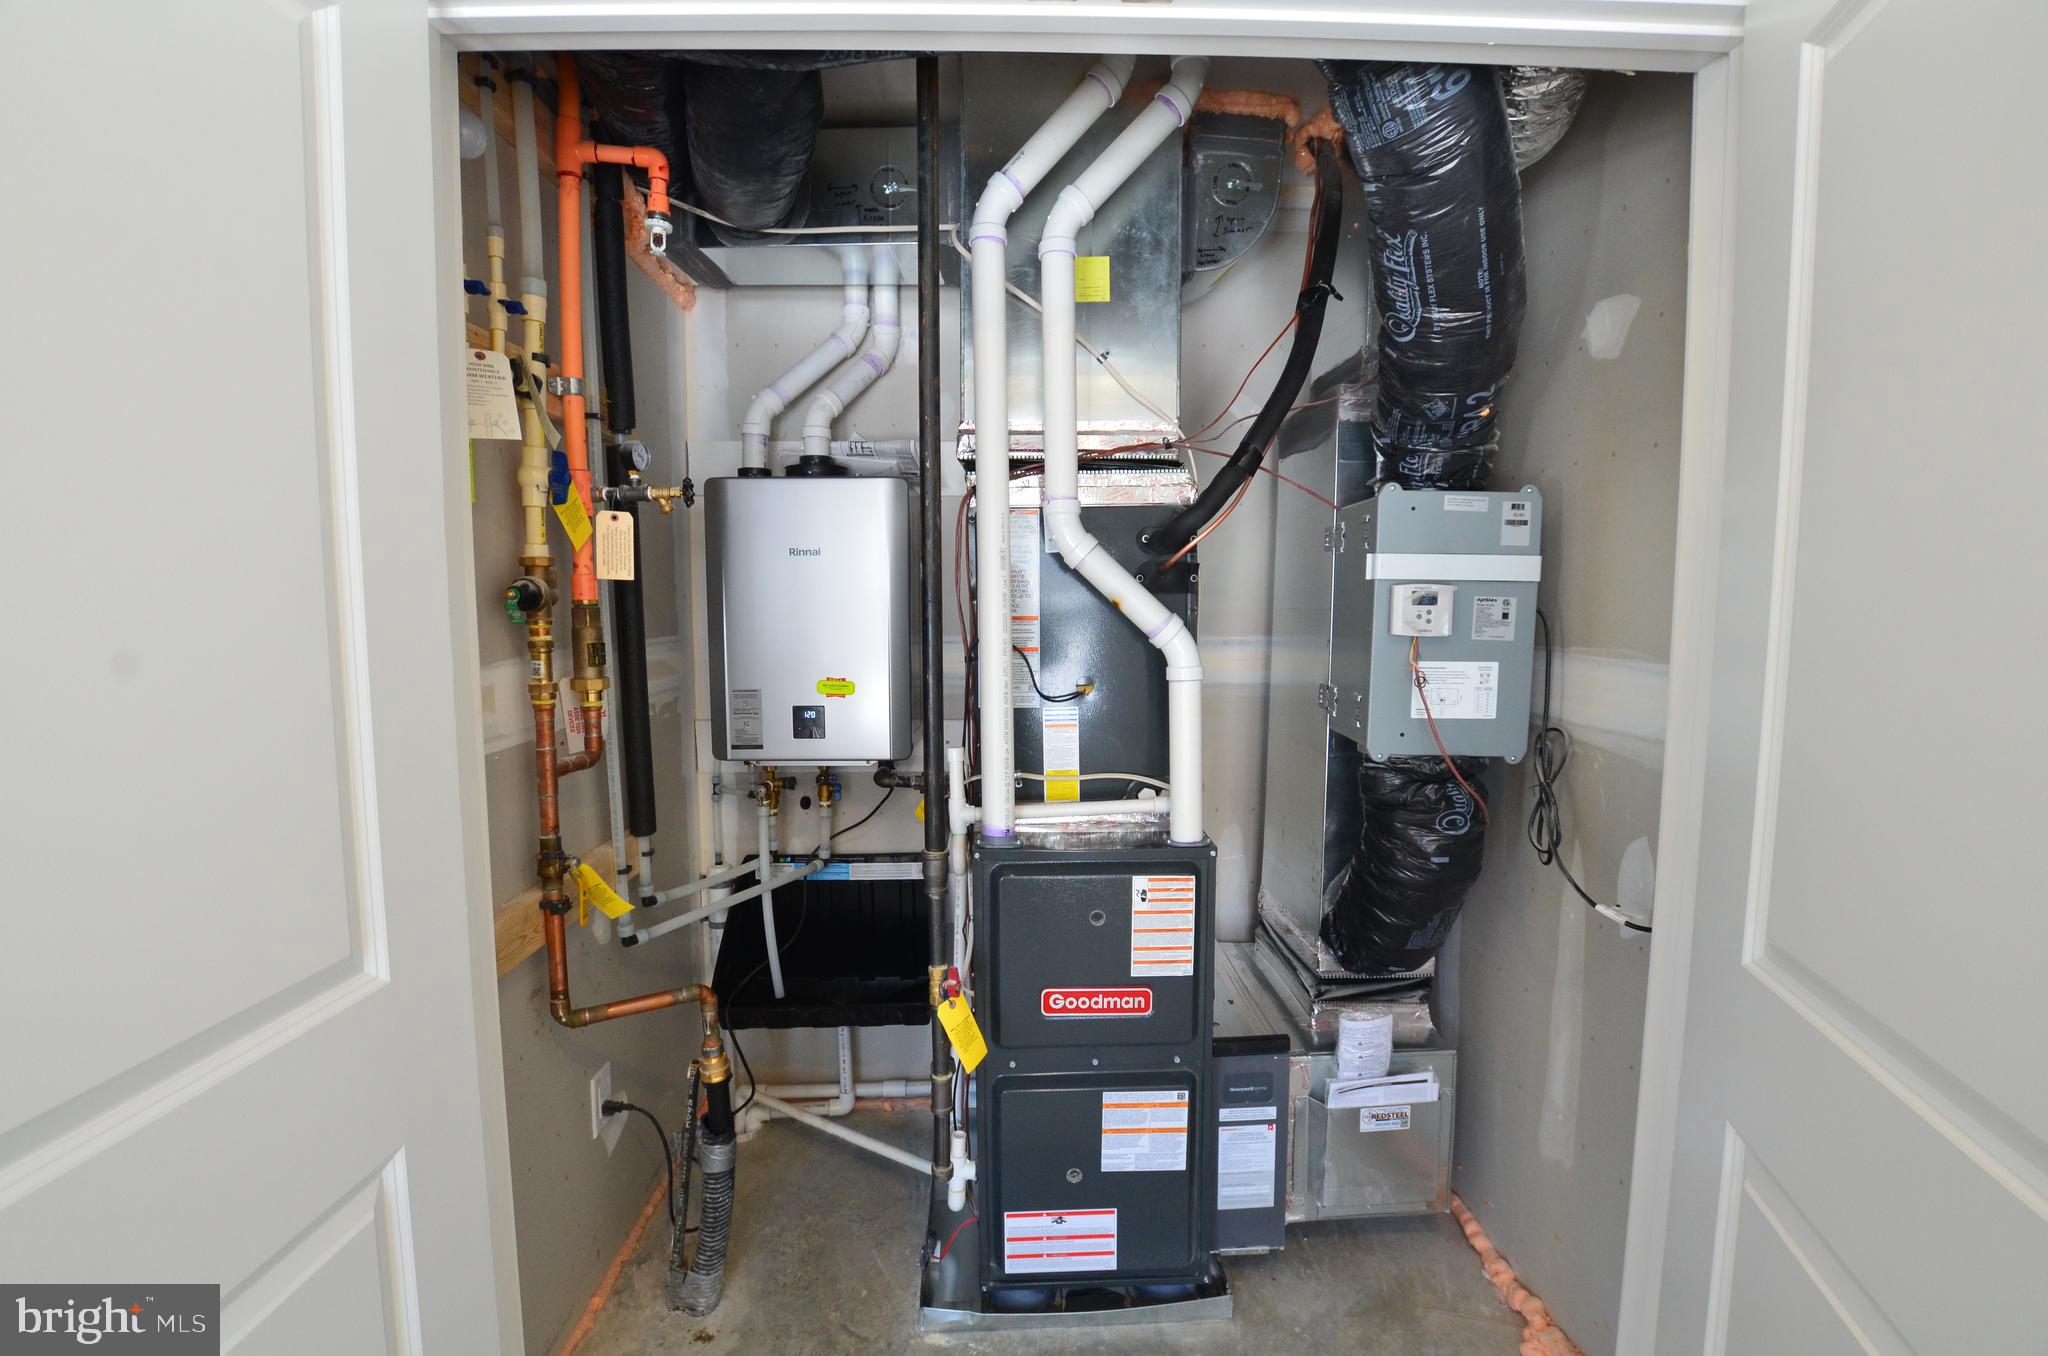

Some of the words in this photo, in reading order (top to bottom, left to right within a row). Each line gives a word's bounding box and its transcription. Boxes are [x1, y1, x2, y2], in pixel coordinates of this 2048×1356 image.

[1477, 207, 1486, 226] ONLY
[1420, 231, 1430, 247] INC.
[1383, 232, 1411, 274] Flex
[1481, 243, 1489, 270] INDOOR
[1422, 248, 1434, 283] SYSTEMS
[1427, 282, 1437, 302] FLEX
[1384, 274, 1421, 342] Quality
[1433, 322, 1441, 331] BY
[788, 547, 821, 557] Rinnai
[804, 710, 816, 719] 120
[1048, 993, 1146, 1010] Goodman
[1370, 1111, 1409, 1120] REDSTEEL
